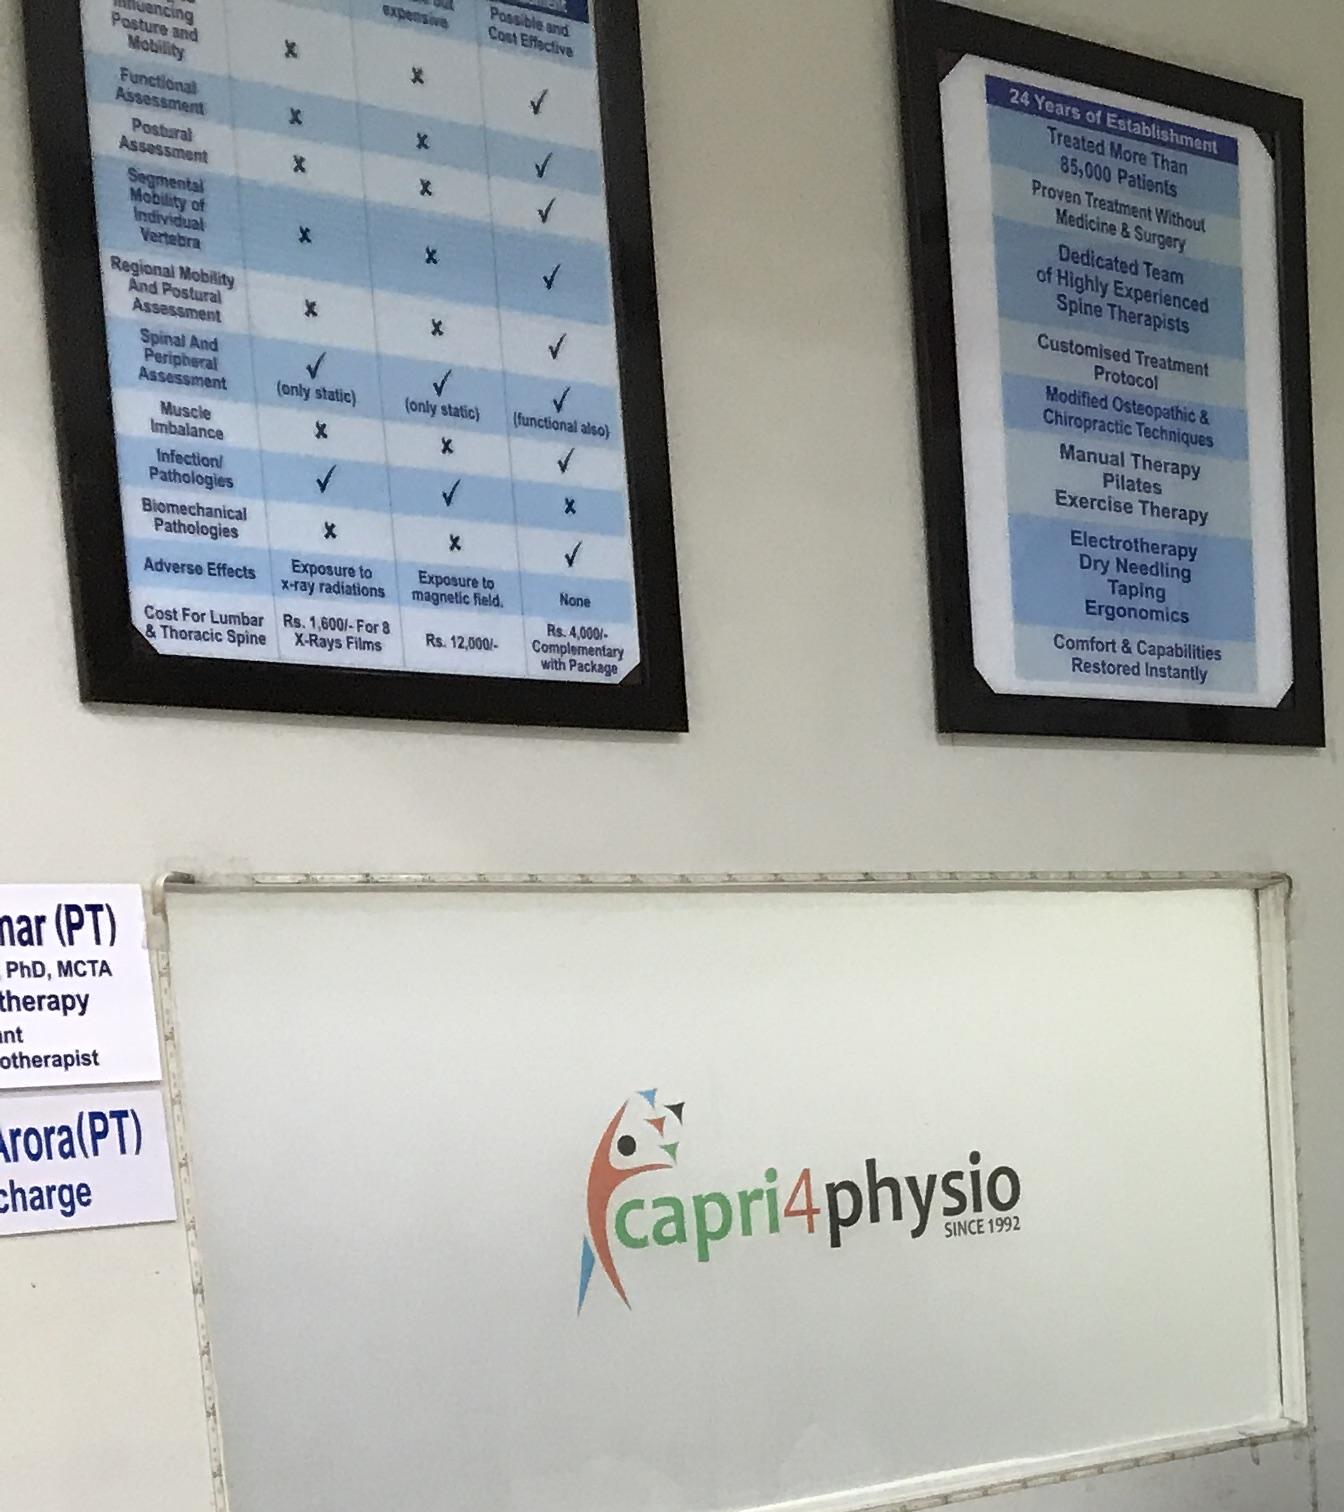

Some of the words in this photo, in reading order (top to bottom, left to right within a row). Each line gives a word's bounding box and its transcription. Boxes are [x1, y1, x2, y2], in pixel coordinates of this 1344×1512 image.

[112, 11, 168, 36] Posture
[172, 27, 198, 42] and
[490, 6, 543, 31] Possible
[546, 21, 570, 38] and
[128, 34, 185, 61] Mobility
[488, 26, 518, 46] Cost
[520, 33, 574, 58] Effective
[120, 67, 198, 95] Functional
[116, 87, 205, 115] Assessment
[131, 118, 193, 142] Postural
[1008, 88, 1030, 106] 24
[1034, 93, 1081, 123] Years
[1085, 107, 1103, 126] of
[1105, 112, 1219, 155] Establishment
[119, 136, 208, 164] Assessment
[1046, 125, 1105, 157] Treated
[1109, 140, 1148, 166] More
[1151, 150, 1188, 176] Than
[128, 168, 204, 193] Segmental
[1059, 155, 1112, 184] 85,000
[1117, 168, 1178, 198] Patients
[130, 187, 187, 212] Mobility
[191, 200, 205, 212] of
[1031, 178, 1082, 207] Proven
[1085, 190, 1152, 222] Treatment
[1155, 207, 1206, 232] Without
[134, 206, 205, 232] Individual
[1055, 207, 1117, 238] Medicine
[1120, 219, 1131, 239] &
[1134, 224, 1187, 254] Surgery
[140, 226, 201, 250] Vertebra
[111, 255, 175, 278] Regional
[179, 266, 235, 290] Mobility
[1058, 244, 1139, 277] Dedicated
[1142, 260, 1184, 286] Team
[129, 278, 157, 295] And
[162, 282, 222, 304] Postural
[1036, 265, 1054, 286] of
[1056, 269, 1108, 298] Highly
[1113, 281, 1209, 315] Experienced
[132, 298, 222, 323] Assessment
[1056, 293, 1103, 321] Spine
[1108, 303, 1190, 335] Therapists
[140, 328, 186, 349] Spinal
[189, 336, 219, 352] And
[144, 348, 218, 371] Peripheral
[1037, 332, 1131, 365] Customised
[1134, 350, 1209, 378] Treatment
[139, 366, 227, 390] Assessment
[1094, 364, 1159, 391] Protocol
[276, 380, 311, 401] (only
[315, 384, 357, 407] static)
[1045, 385, 1108, 411] Modified
[1112, 395, 1196, 425] Osteopathic
[1199, 408, 1210, 426] &
[160, 401, 211, 420] Muscle
[405, 396, 437, 418] (only
[440, 403, 480, 422] static)
[150, 419, 224, 440] Imbalance
[513, 411, 577, 433] (functional
[581, 421, 610, 440] also)
[1042, 407, 1133, 438] Chiropractic
[1136, 421, 1214, 449] Techniques
[157, 448, 224, 469] Infection/
[1059, 442, 1125, 469] Manual
[1131, 451, 1201, 481] Therapy
[149, 466, 234, 490] Pathologies
[1102, 472, 1162, 496] Pilates
[142, 497, 247, 521] Biomechanical
[1055, 489, 1133, 515] Exercise
[1138, 500, 1209, 527] Therapy
[154, 517, 239, 540] Pathologies
[1070, 529, 1198, 562] Electrotherapy
[143, 557, 203, 576] Adverse
[207, 561, 256, 580] Effects
[291, 559, 356, 580] Exposure
[359, 564, 373, 580] to
[418, 570, 479, 591] Exposure
[482, 576, 496, 591] to
[1078, 553, 1109, 576] Dry
[1115, 557, 1192, 584] Needling
[281, 579, 315, 596] x-ray
[319, 580, 386, 599] radiations
[412, 590, 471, 608] magnetic
[559, 592, 592, 609] None
[1107, 578, 1166, 603] Taping
[144, 604, 178, 623] Cost
[182, 607, 206, 624] For
[210, 610, 264, 628] Lumbar
[283, 613, 306, 630] Rs.
[357, 618, 379, 635] For
[382, 620, 391, 635] 8
[1085, 599, 1190, 624] Ergonomics
[144, 623, 156, 640] &
[160, 625, 222, 643] Thoracic
[227, 628, 267, 648] Spine
[294, 632, 343, 651] X-Rays
[346, 635, 383, 652] Films
[425, 633, 447, 649] Rs.
[450, 634, 499, 651] 12,000/-
[547, 623, 568, 639] Rs.
[532, 639, 625, 661] Complementary
[1053, 633, 1117, 654] Comfort
[1120, 638, 1132, 655] &
[1136, 639, 1222, 661] Capabilities
[541, 656, 567, 673] with
[569, 659, 618, 677] Package
[1071, 656, 1141, 678] Restored
[1144, 661, 1208, 684] Instantly
[55, 902, 117, 948] (PT)
[6, 960, 52, 981] PhD,
[57, 959, 113, 978] MCTA
[0, 1026, 24, 1044] nt
[0, 1050, 100, 1072] otherapist
[614, 1151, 1022, 1263] capri4physio
[944, 1219, 985, 1238] SINCE
[987, 1216, 1022, 1235] 1992
